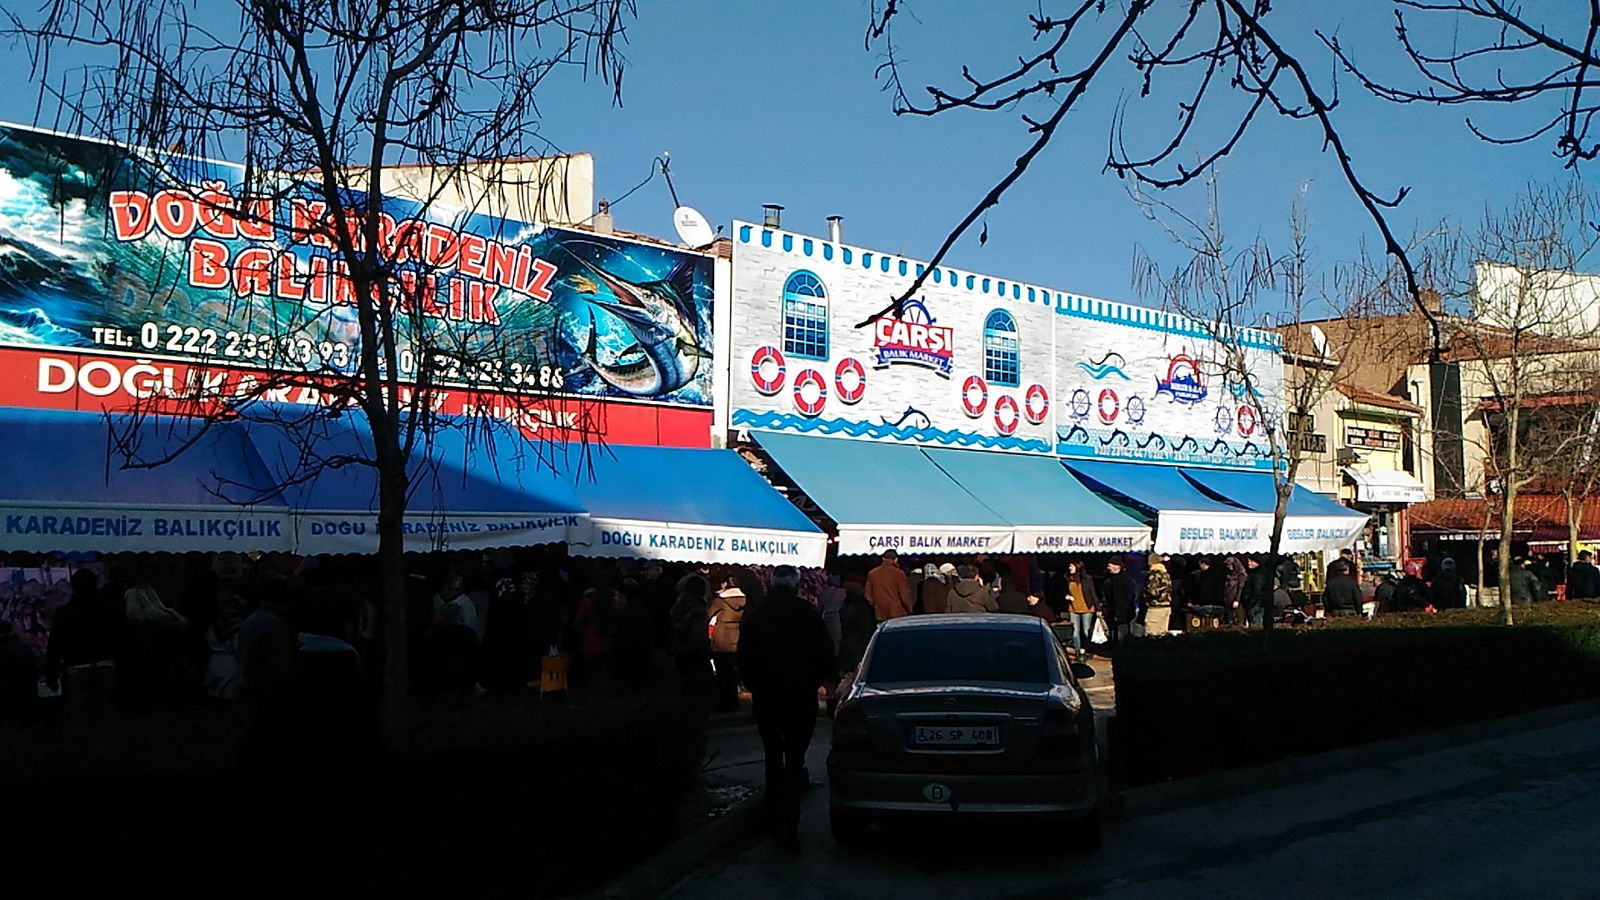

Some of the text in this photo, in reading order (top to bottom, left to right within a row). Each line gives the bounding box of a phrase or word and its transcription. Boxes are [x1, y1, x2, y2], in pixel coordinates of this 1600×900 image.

[109, 181, 276, 241] DOĞU
[92, 327, 134, 348] TEL:
[140, 321, 159, 350] 0
[166, 324, 218, 356] 222
[318, 341, 349, 368] 93
[875, 318, 953, 353] ÇARŞI
[38, 356, 195, 402] DOĞU
[6, 515, 281, 540] KARADENİZ BALIKÇILIK
[311, 520, 366, 536] DOĞU
[374, 519, 481, 537] RADENİZ
[601, 530, 800, 557] DOĞU KARADENİZ BALIKÇILIK
[869, 536, 992, 550] ÇARŞI BALIK MARKET
[1035, 536, 1134, 549] ÇARŞI BALIK MARKET
[929, 729, 993, 741] 26 SP 408
